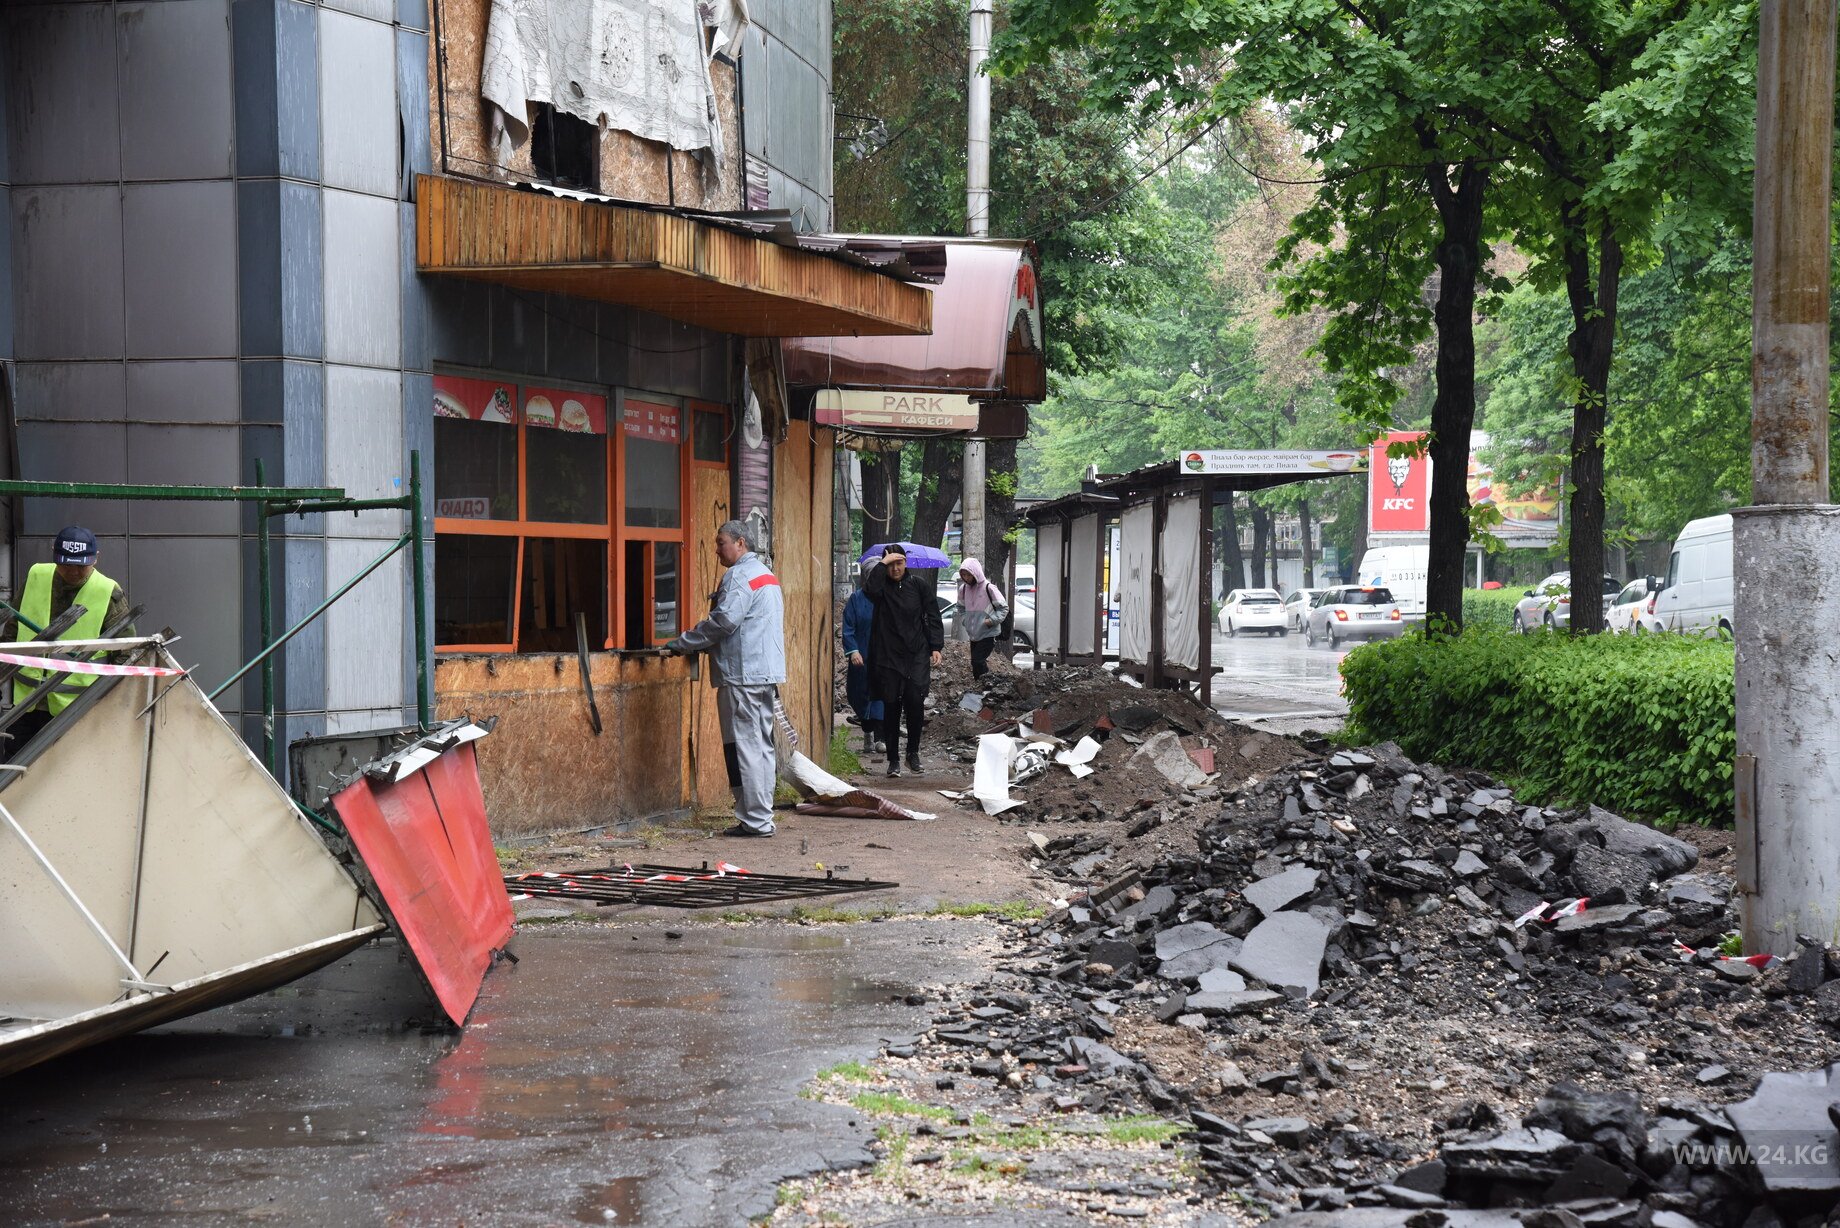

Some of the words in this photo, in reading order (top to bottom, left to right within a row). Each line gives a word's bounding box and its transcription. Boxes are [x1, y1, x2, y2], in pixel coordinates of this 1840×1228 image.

[882, 395, 944, 412] PARK
[901, 415, 953, 426] КАФЕСИ
[1233, 453, 1246, 462] бар
[1273, 453, 1299, 462] майрам
[1300, 453, 1313, 462] бар
[1382, 498, 1415, 510] KFC
